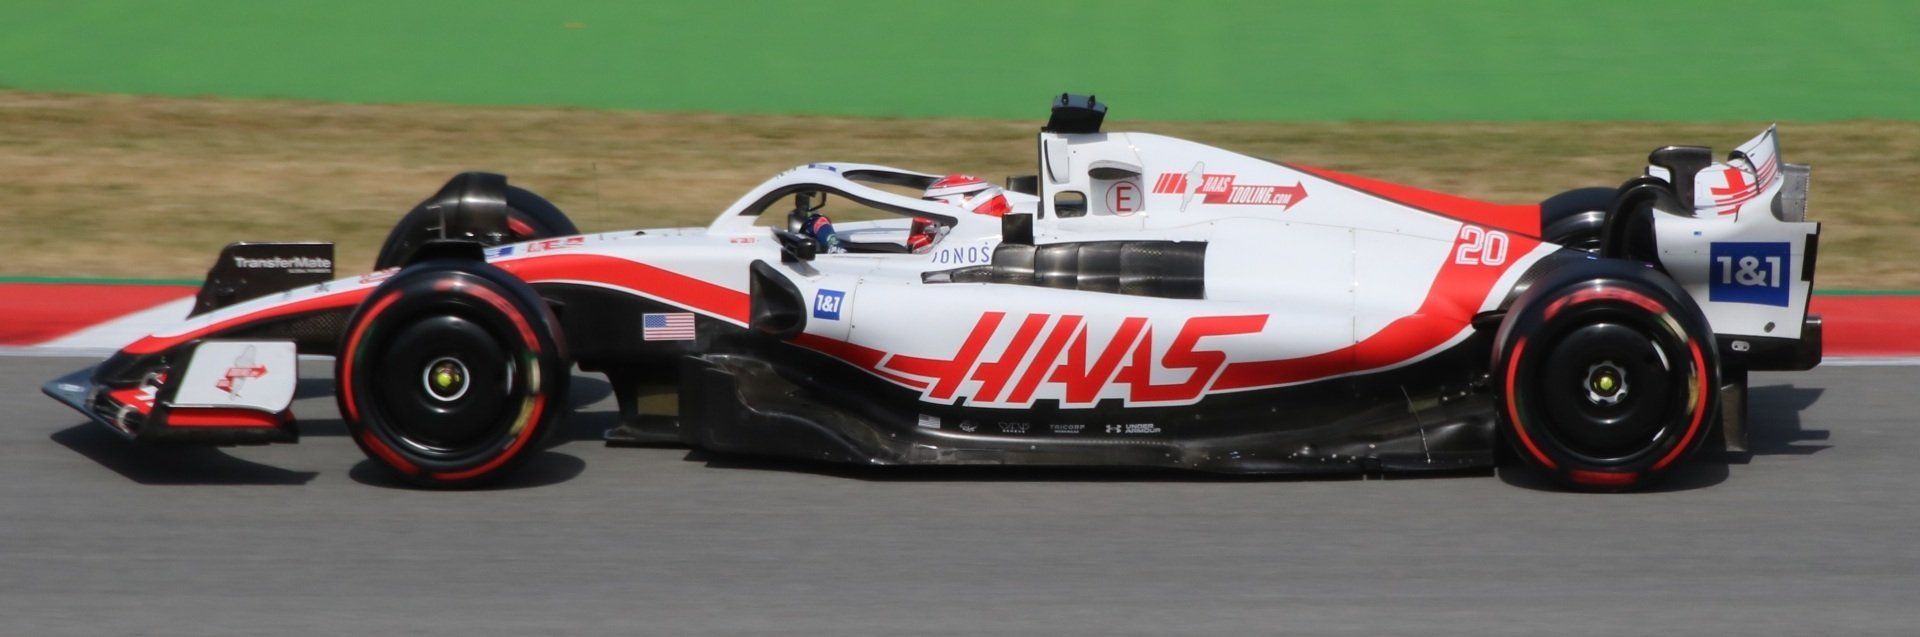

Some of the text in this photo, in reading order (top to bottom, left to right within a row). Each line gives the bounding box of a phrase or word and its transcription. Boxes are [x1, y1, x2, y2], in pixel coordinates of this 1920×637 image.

[1203, 176, 1231, 192] HAAS
[1116, 186, 1132, 212] E
[1455, 224, 1509, 266] 20
[234, 256, 332, 268] TransferMate
[1717, 256, 1781, 288] 1&1
[817, 294, 841, 313] 1&1
[884, 311, 1270, 405] HAAS
